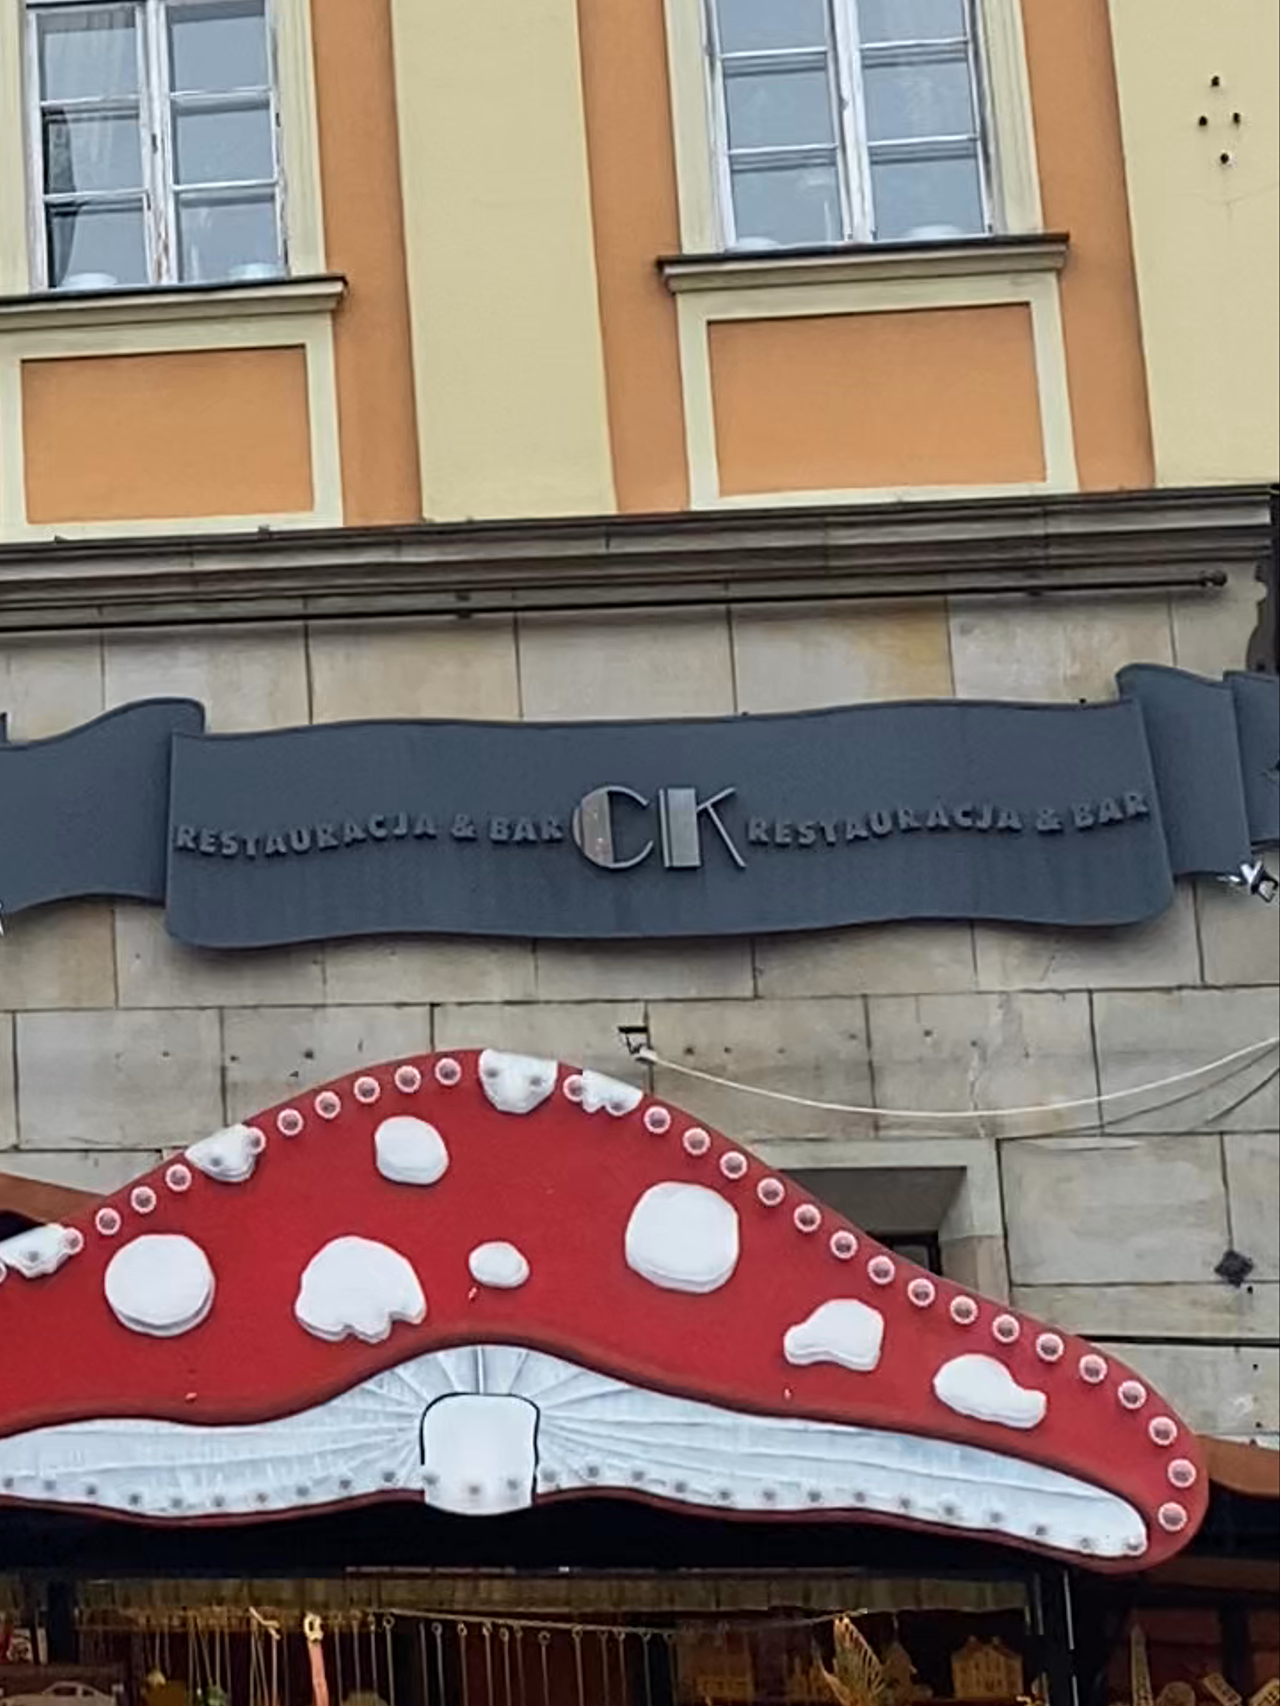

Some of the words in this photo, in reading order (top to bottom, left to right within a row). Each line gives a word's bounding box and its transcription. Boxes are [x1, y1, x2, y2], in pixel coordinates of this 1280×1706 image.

[174, 811, 438, 858] RESTAURACJA
[450, 812, 478, 840] &
[489, 815, 565, 844] BAR
[572, 785, 746, 870] CK
[747, 803, 1023, 846] RESTAURACJA
[1036, 808, 1065, 833] &
[1072, 790, 1150, 830] BAR
